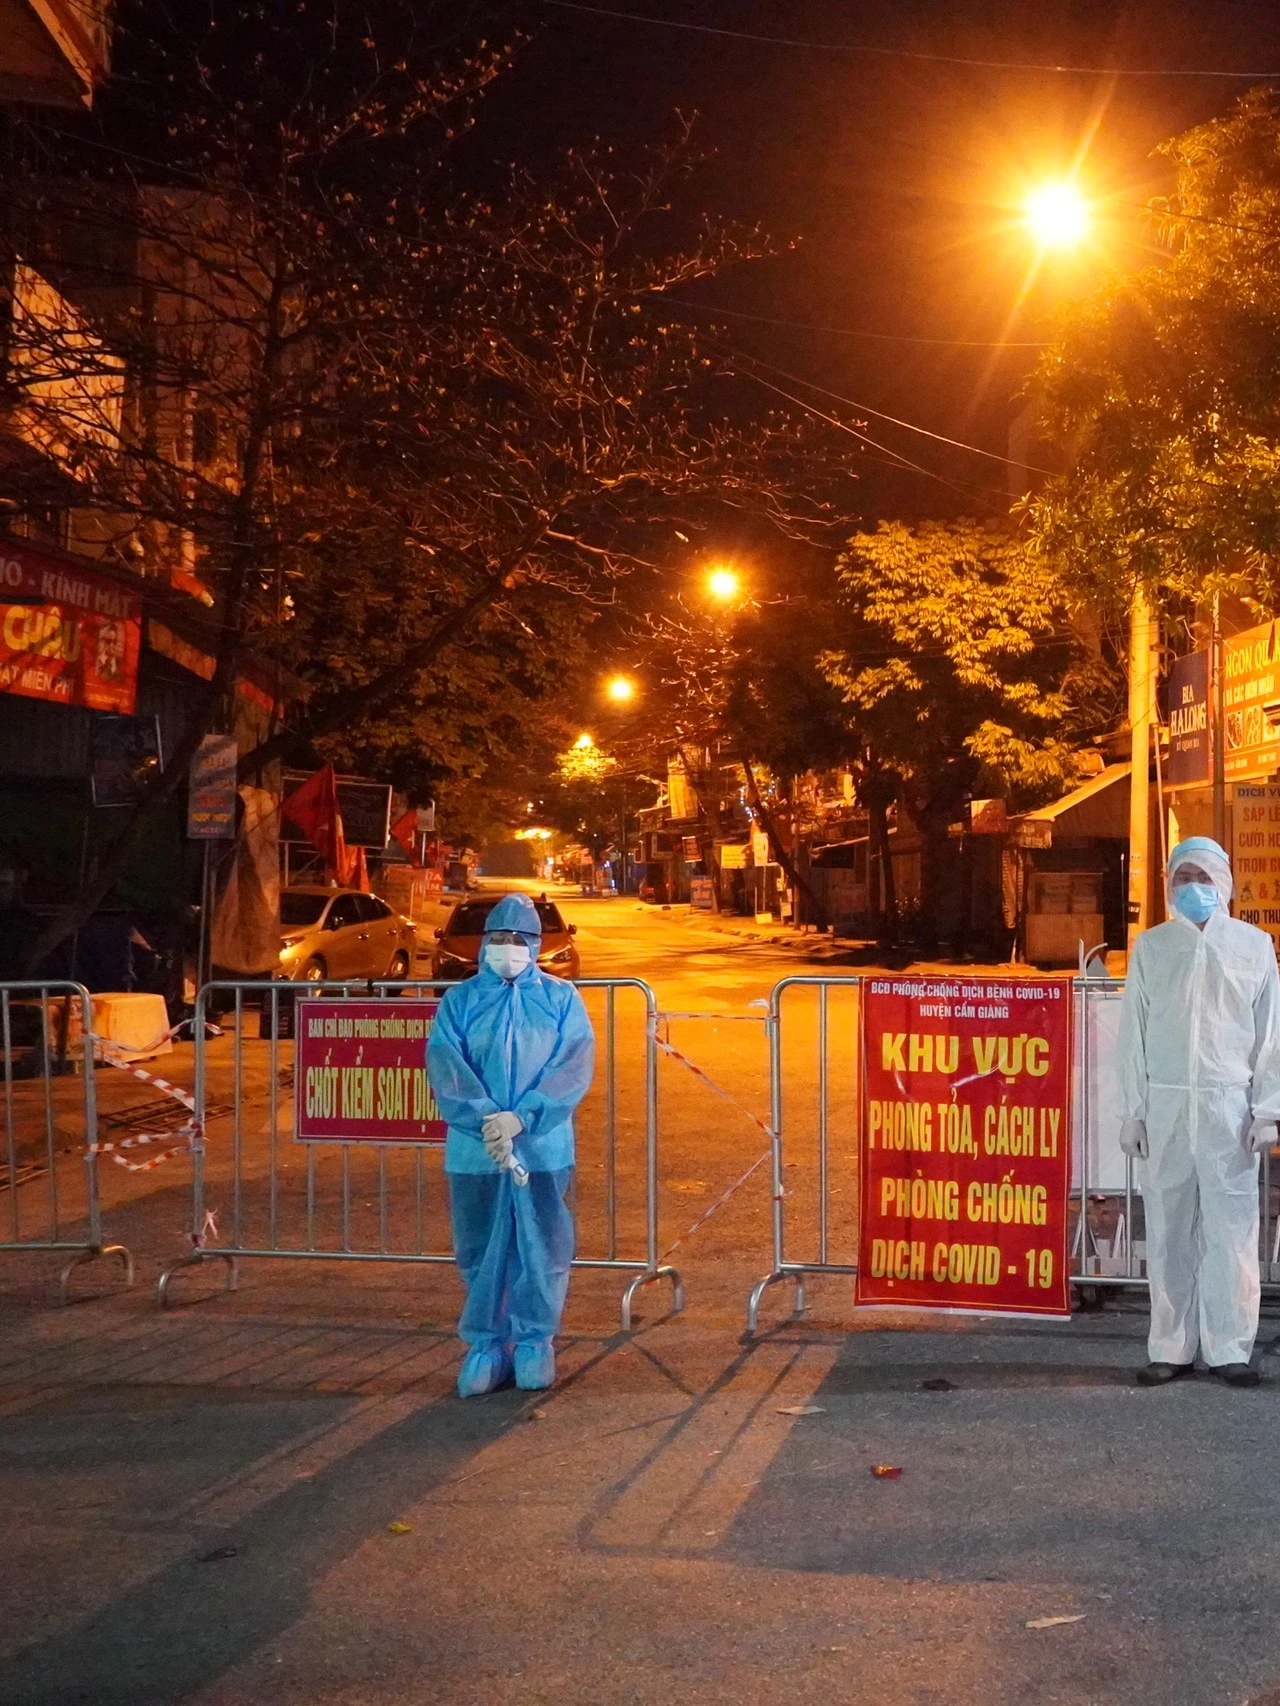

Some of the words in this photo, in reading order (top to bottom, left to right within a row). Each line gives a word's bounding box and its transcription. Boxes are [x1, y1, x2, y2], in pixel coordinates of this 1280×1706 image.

[1225, 645, 1253, 680] NGON
[1239, 909, 1260, 925] CHO
[919, 1002, 951, 1020] HUYỆN
[977, 1003, 1009, 1019] GIÀNG
[927, 981, 960, 998] CHỐNG
[962, 985, 984, 1000] DỊCH
[986, 984, 1013, 1001] BỆNH
[1015, 987, 1060, 999] COVID-19
[308, 1018, 324, 1038] BAN
[354, 1013, 379, 1038] PHÒNG
[380, 1012, 405, 1038] CHỐNG
[406, 1019, 424, 1043] DỊCH
[881, 1032, 960, 1074] KHU
[972, 1032, 1050, 1084] VỰC
[306, 1047, 339, 1119] CHỐT
[341, 1045, 374, 1119] KIỂM
[377, 1056, 411, 1120] SOÁT
[413, 1067, 443, 1133] DỊC
[869, 1100, 933, 1152] PHONG
[937, 1087, 979, 1161] TỎA,
[984, 1094, 1034, 1157] CÁCH
[1039, 1107, 1061, 1158] LY
[881, 1169, 960, 1221] PHÒNG
[967, 1169, 1047, 1226] CHỐNG
[871, 1239, 926, 1288] DỊCH
[932, 1241, 1000, 1286] COVID
[1025, 1249, 1053, 1289] 19
